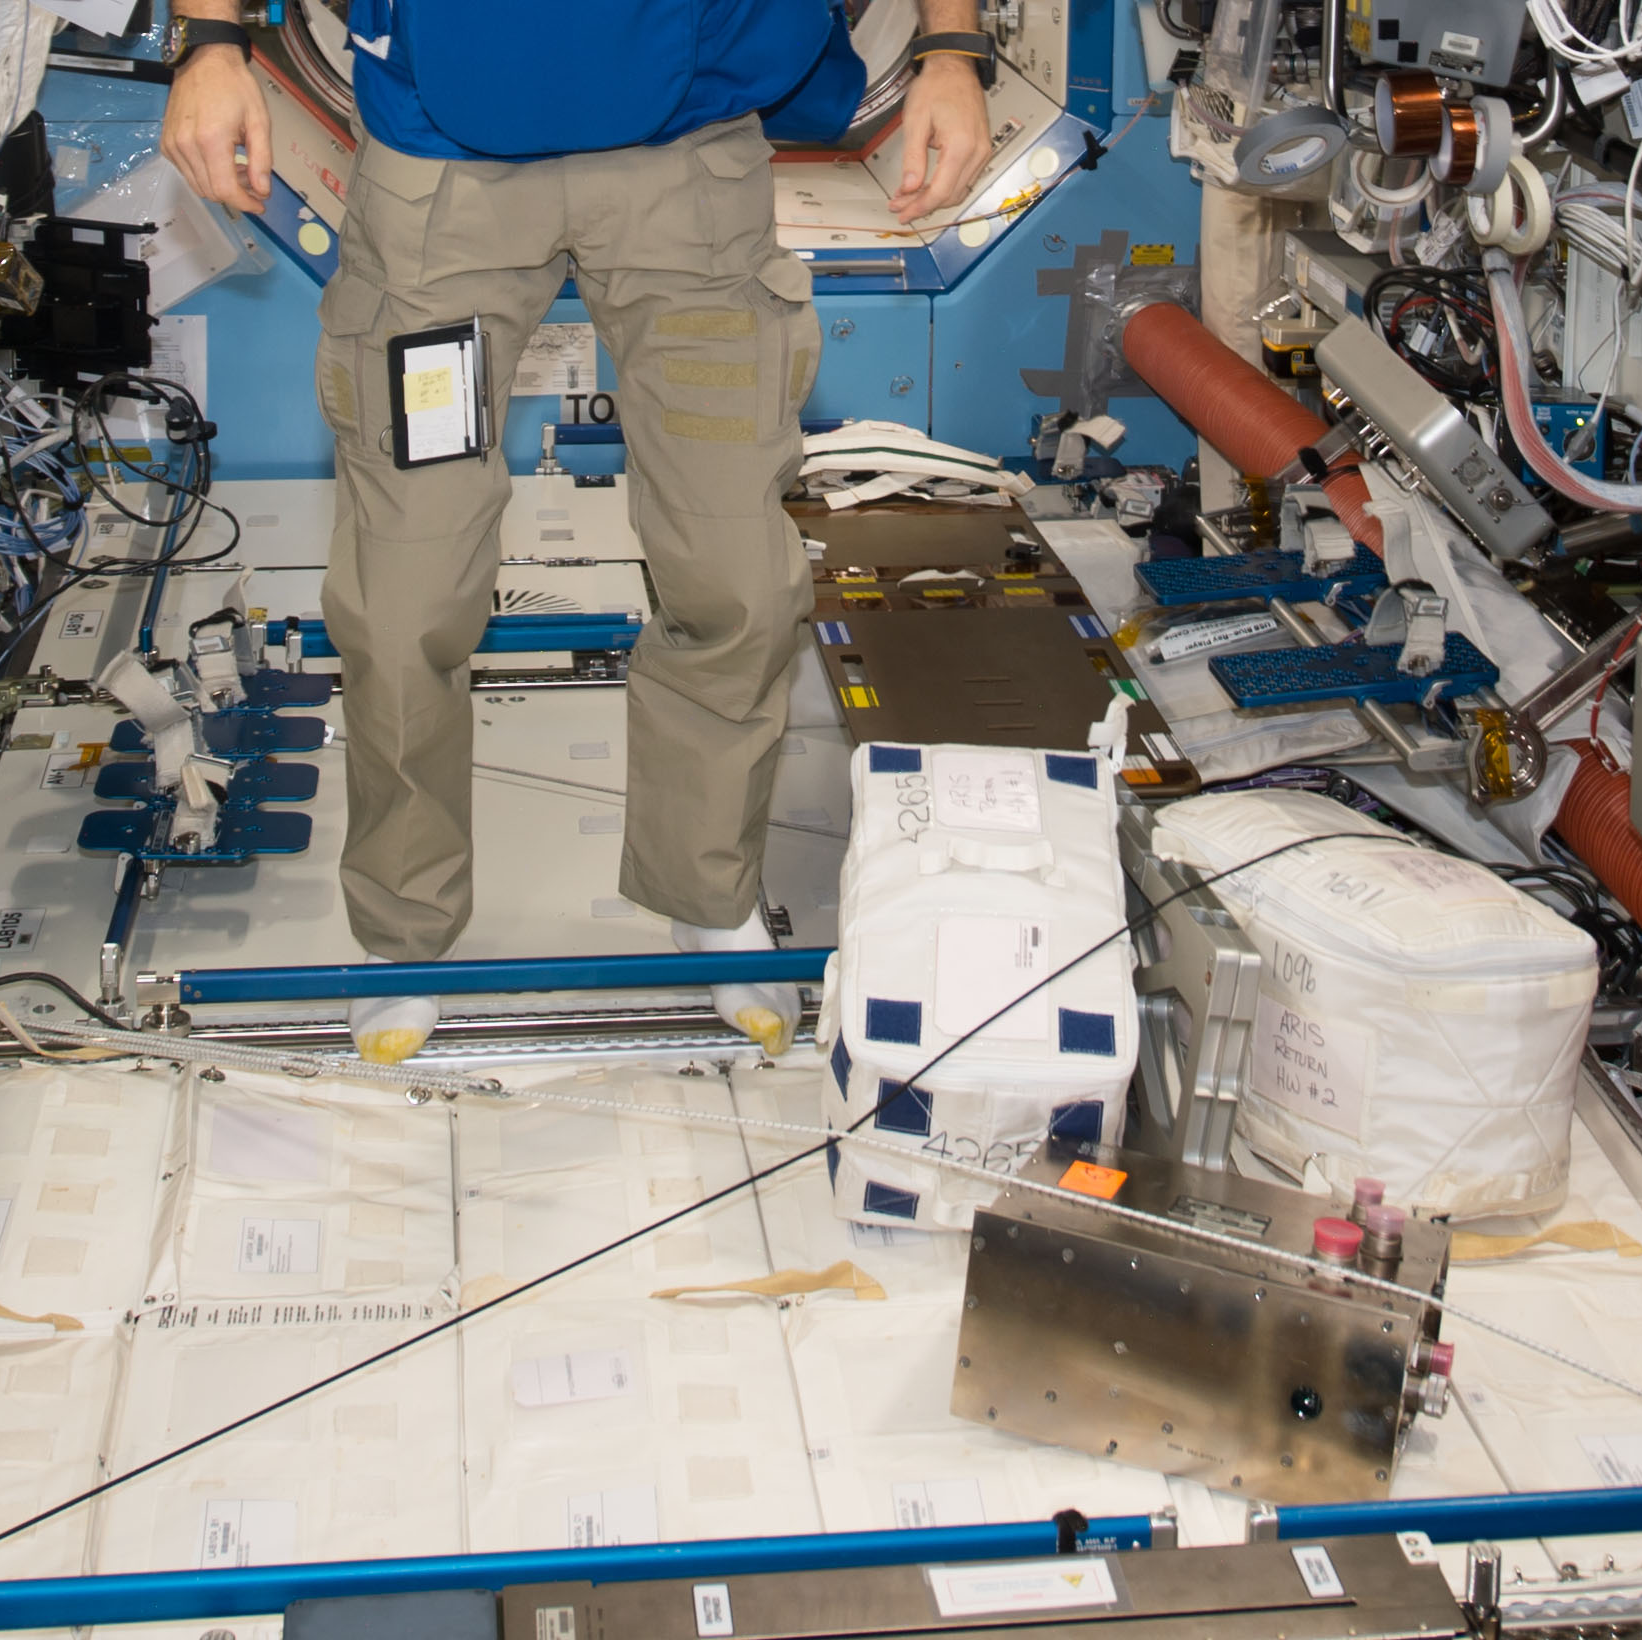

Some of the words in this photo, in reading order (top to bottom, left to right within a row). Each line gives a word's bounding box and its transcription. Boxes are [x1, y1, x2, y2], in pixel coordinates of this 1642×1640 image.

[565, 392, 615, 425] TO
[1253, 622, 1271, 632] USB
[1185, 639, 1212, 651] Player
[1272, 940, 1317, 995] 1096
[1279, 1010, 1325, 1047] ARIS
[1272, 1034, 1328, 1080] RETURN
[1276, 1064, 1301, 1095] HW
